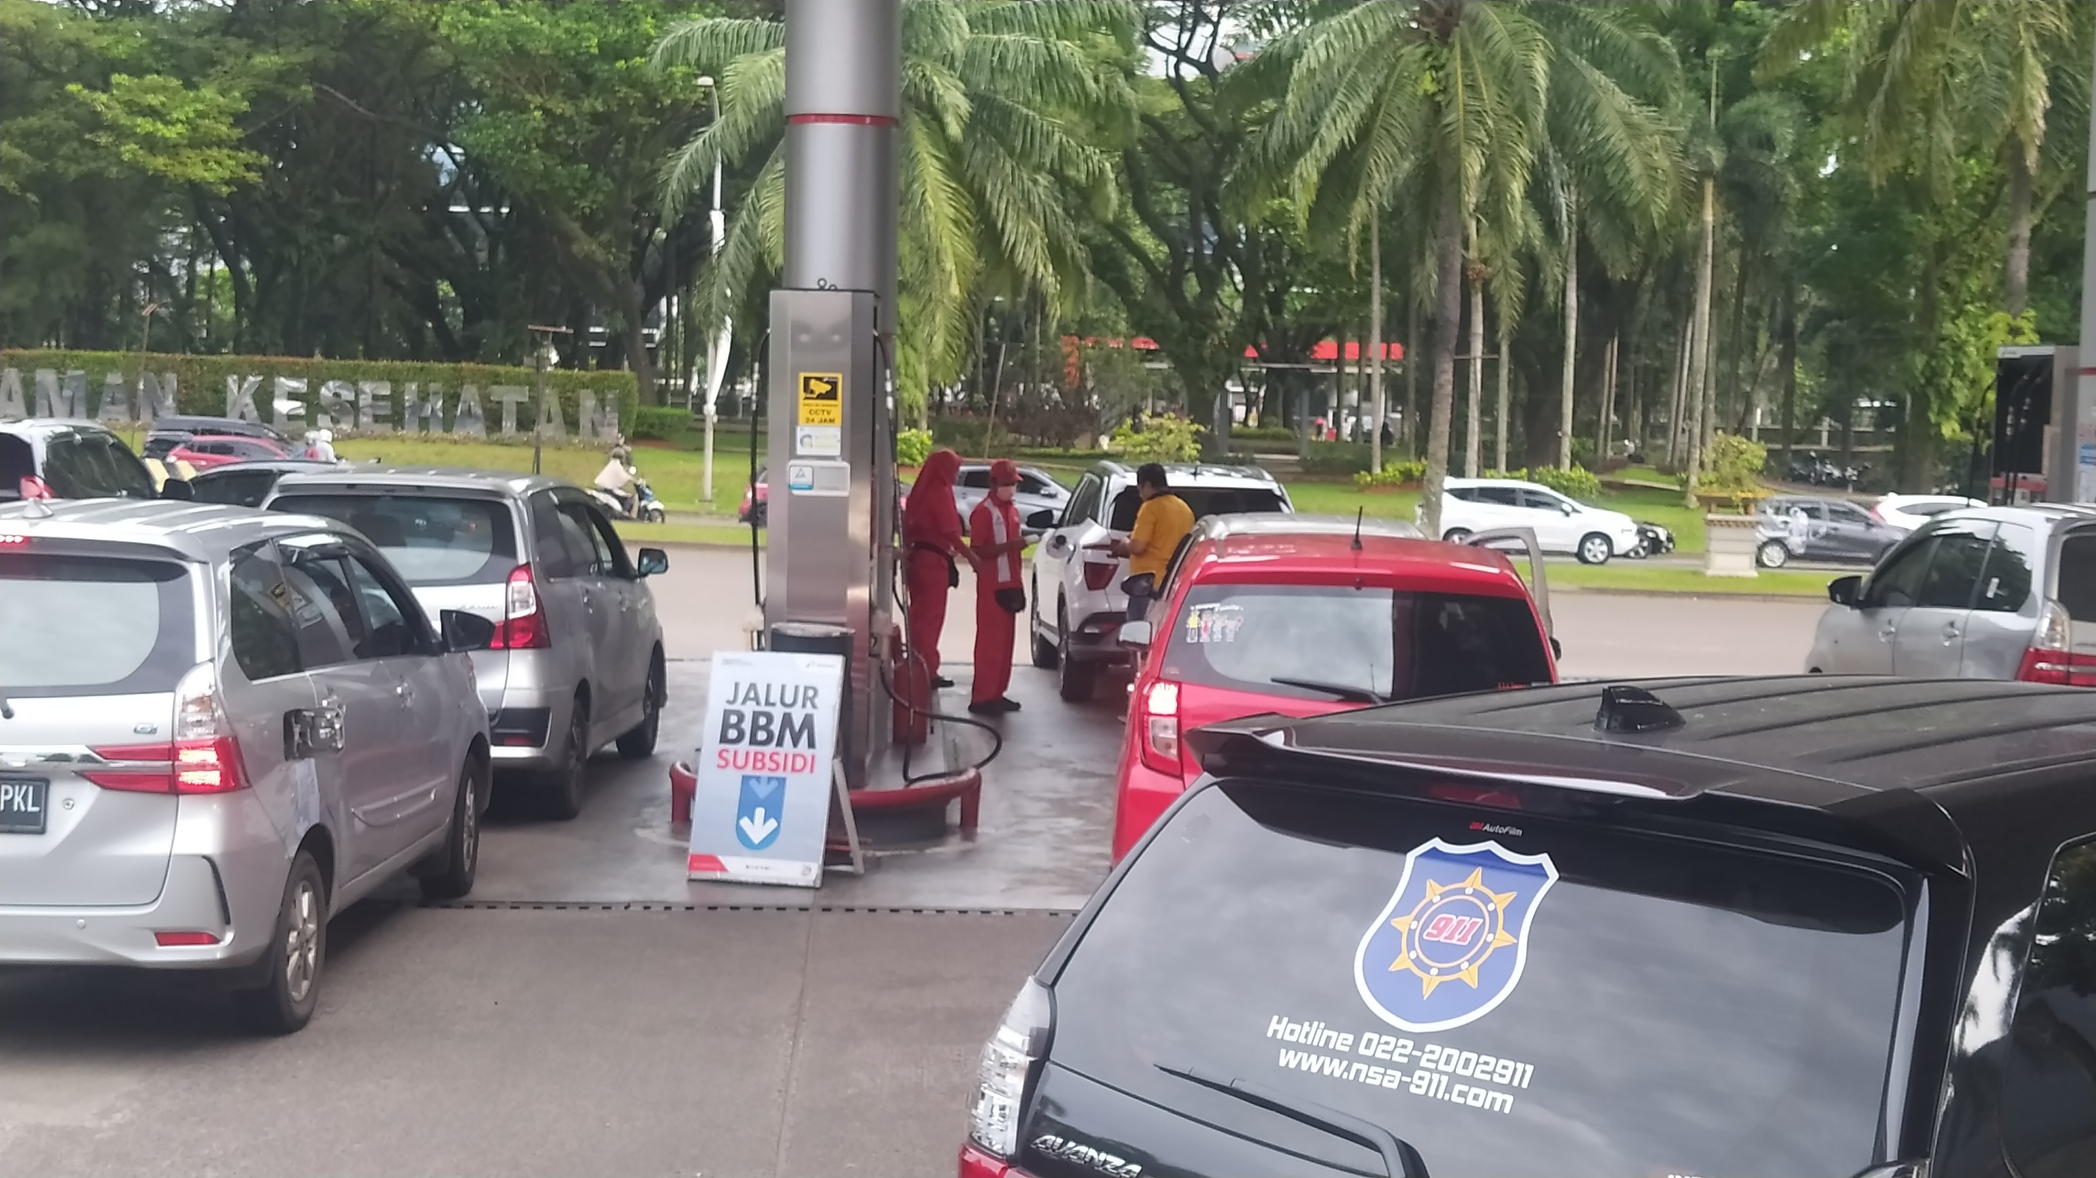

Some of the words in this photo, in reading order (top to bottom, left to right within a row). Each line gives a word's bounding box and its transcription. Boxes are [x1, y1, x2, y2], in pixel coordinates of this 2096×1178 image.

[226, 374, 618, 440] KESEHATAN
[808, 408, 832, 416] CCTV
[726, 681, 820, 710] JALUR
[719, 709, 817, 749] BBM
[717, 748, 816, 774] SUBSIDI
[1, 784, 41, 812] PKL
[1424, 913, 1484, 945] 911
[1266, 1014, 1354, 1053] Hotline
[1358, 1032, 1534, 1090] 022-2002911
[1278, 1047, 1514, 1114] www.nsa-911.com
[1030, 1134, 1142, 1178] AVANZA
